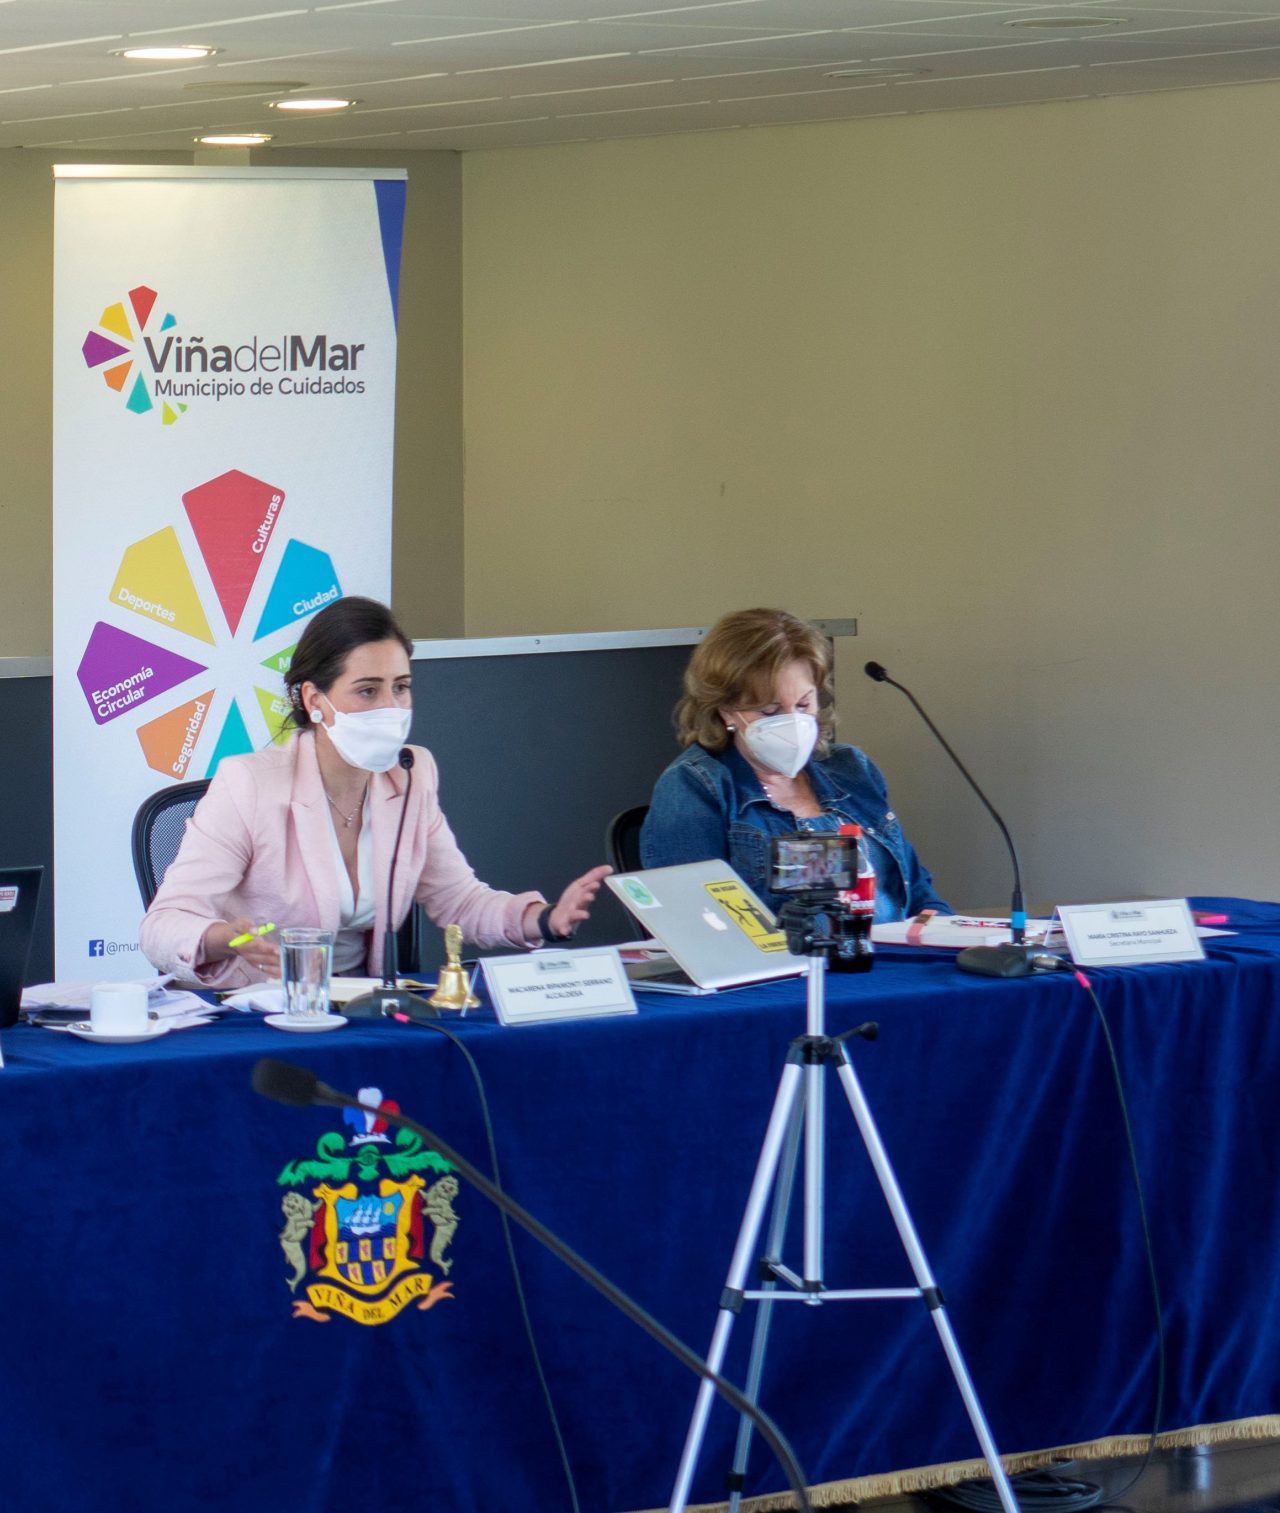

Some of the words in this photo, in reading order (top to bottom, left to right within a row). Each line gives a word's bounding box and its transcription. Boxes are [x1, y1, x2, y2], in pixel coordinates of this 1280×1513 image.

[155, 379, 246, 402] Municipio
[250, 377, 274, 396] de
[278, 376, 366, 396] Cuidados
[252, 493, 281, 554] Culturas
[117, 587, 177, 622] Deportes
[292, 585, 339, 616] Ciudad
[91, 666, 154, 705] Economía
[96, 685, 146, 717] Circular
[172, 701, 207, 774] Seguridad
[313, 1287, 356, 1315] VIÑA
[362, 1307, 385, 1321] DEL
[388, 1276, 425, 1310] MAR
